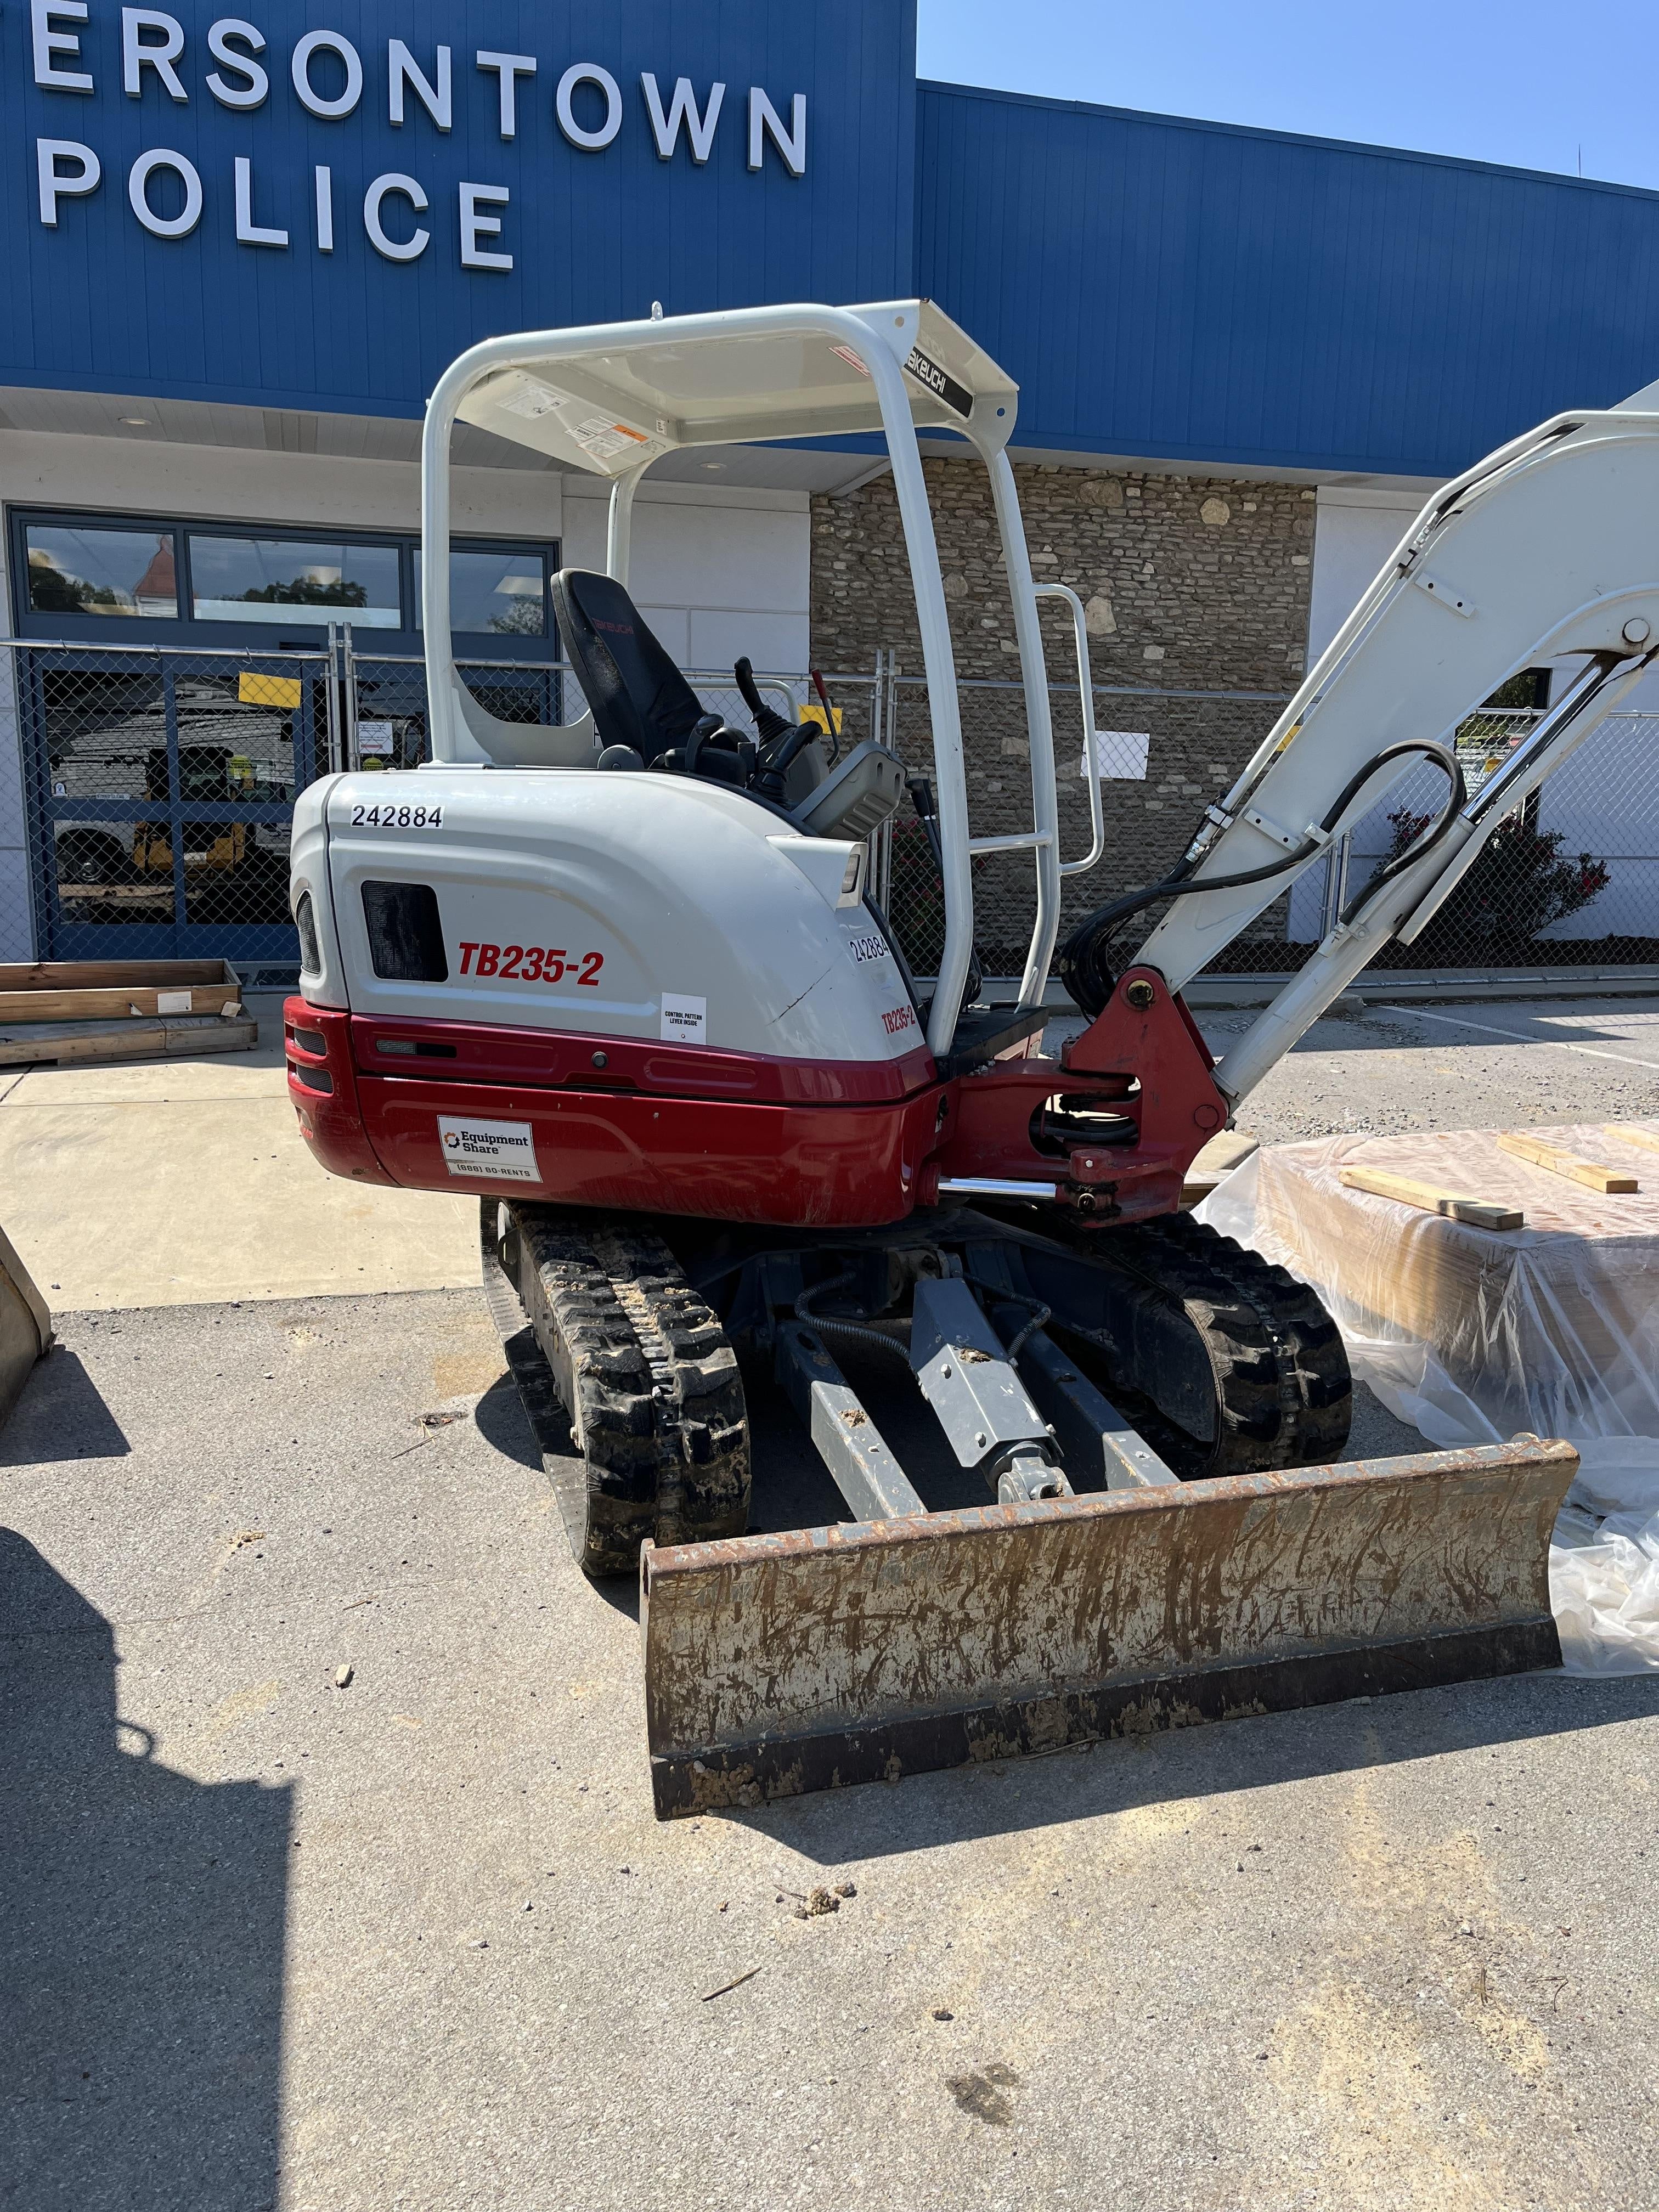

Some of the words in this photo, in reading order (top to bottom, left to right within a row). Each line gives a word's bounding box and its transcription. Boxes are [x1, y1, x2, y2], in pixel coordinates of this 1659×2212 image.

[31, 0, 806, 177] ERSONTOWN
[37, 138, 513, 272] POLICE
[352, 805, 442, 827] 242884
[850, 935, 890, 962] 242884
[459, 942, 603, 986] TB235-2
[882, 1005, 915, 1034] TB235-2
[461, 1131, 528, 1146] Equipment
[463, 1143, 499, 1154] Share
[457, 1164, 482, 1172] (888)
[486, 1167, 531, 1176] 80-RENTS
